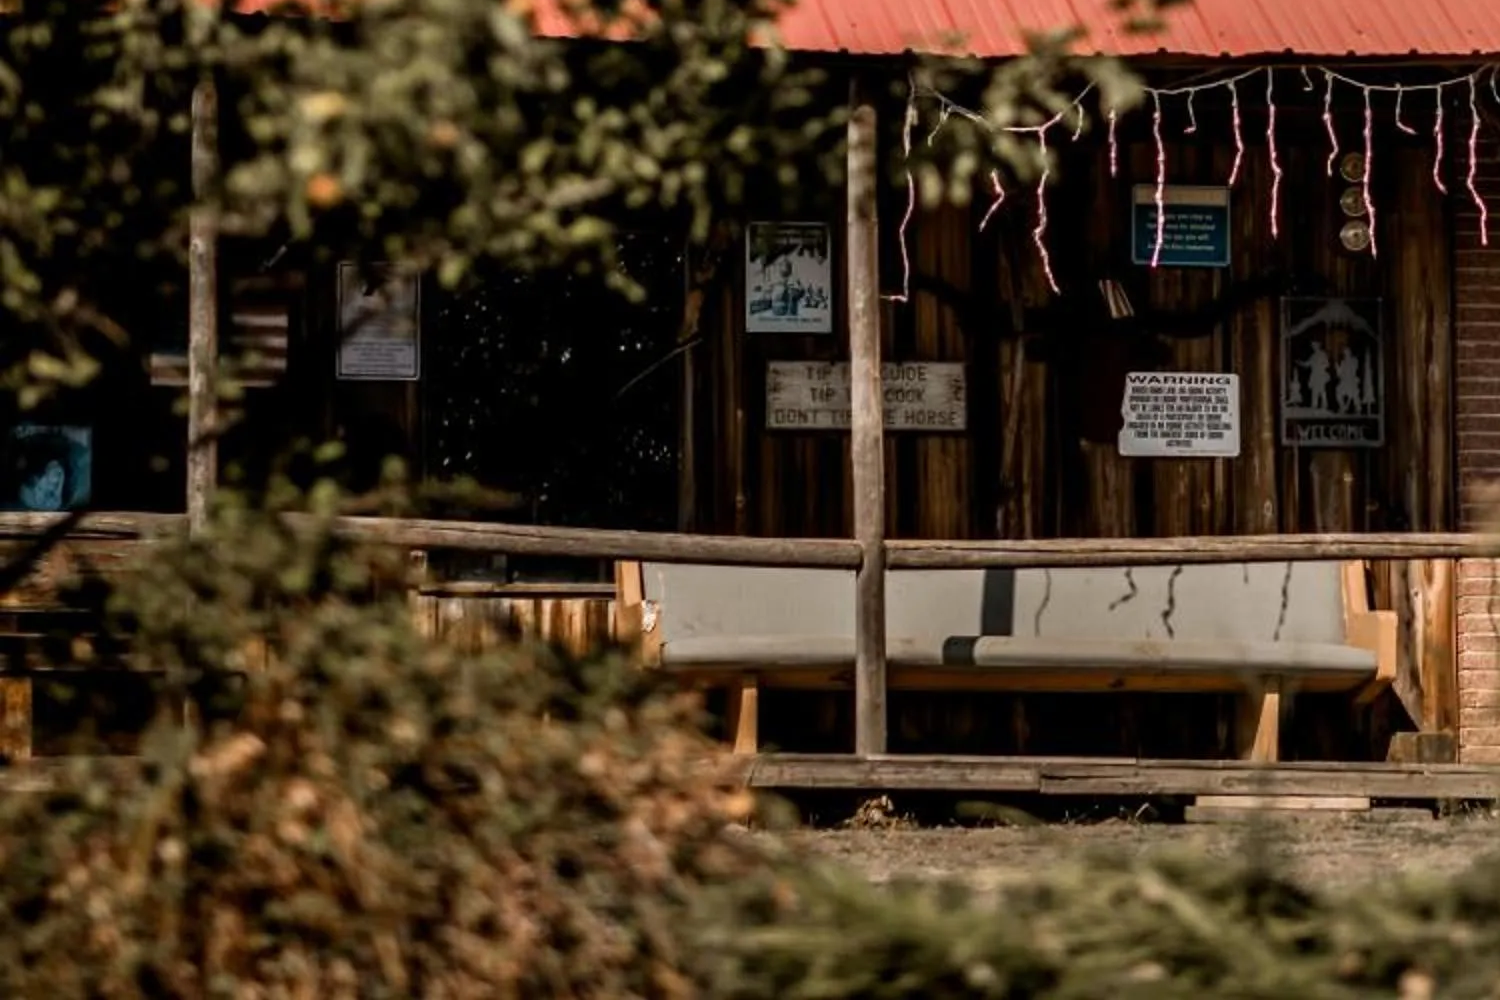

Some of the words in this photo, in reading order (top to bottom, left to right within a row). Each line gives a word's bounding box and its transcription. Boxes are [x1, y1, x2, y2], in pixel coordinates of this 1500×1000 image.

[805, 365, 833, 380] TIP
[1127, 375, 1231, 385] WARNING
[809, 386, 835, 402] TIP
[884, 388, 926, 403] COOK
[904, 410, 957, 427] HORSE
